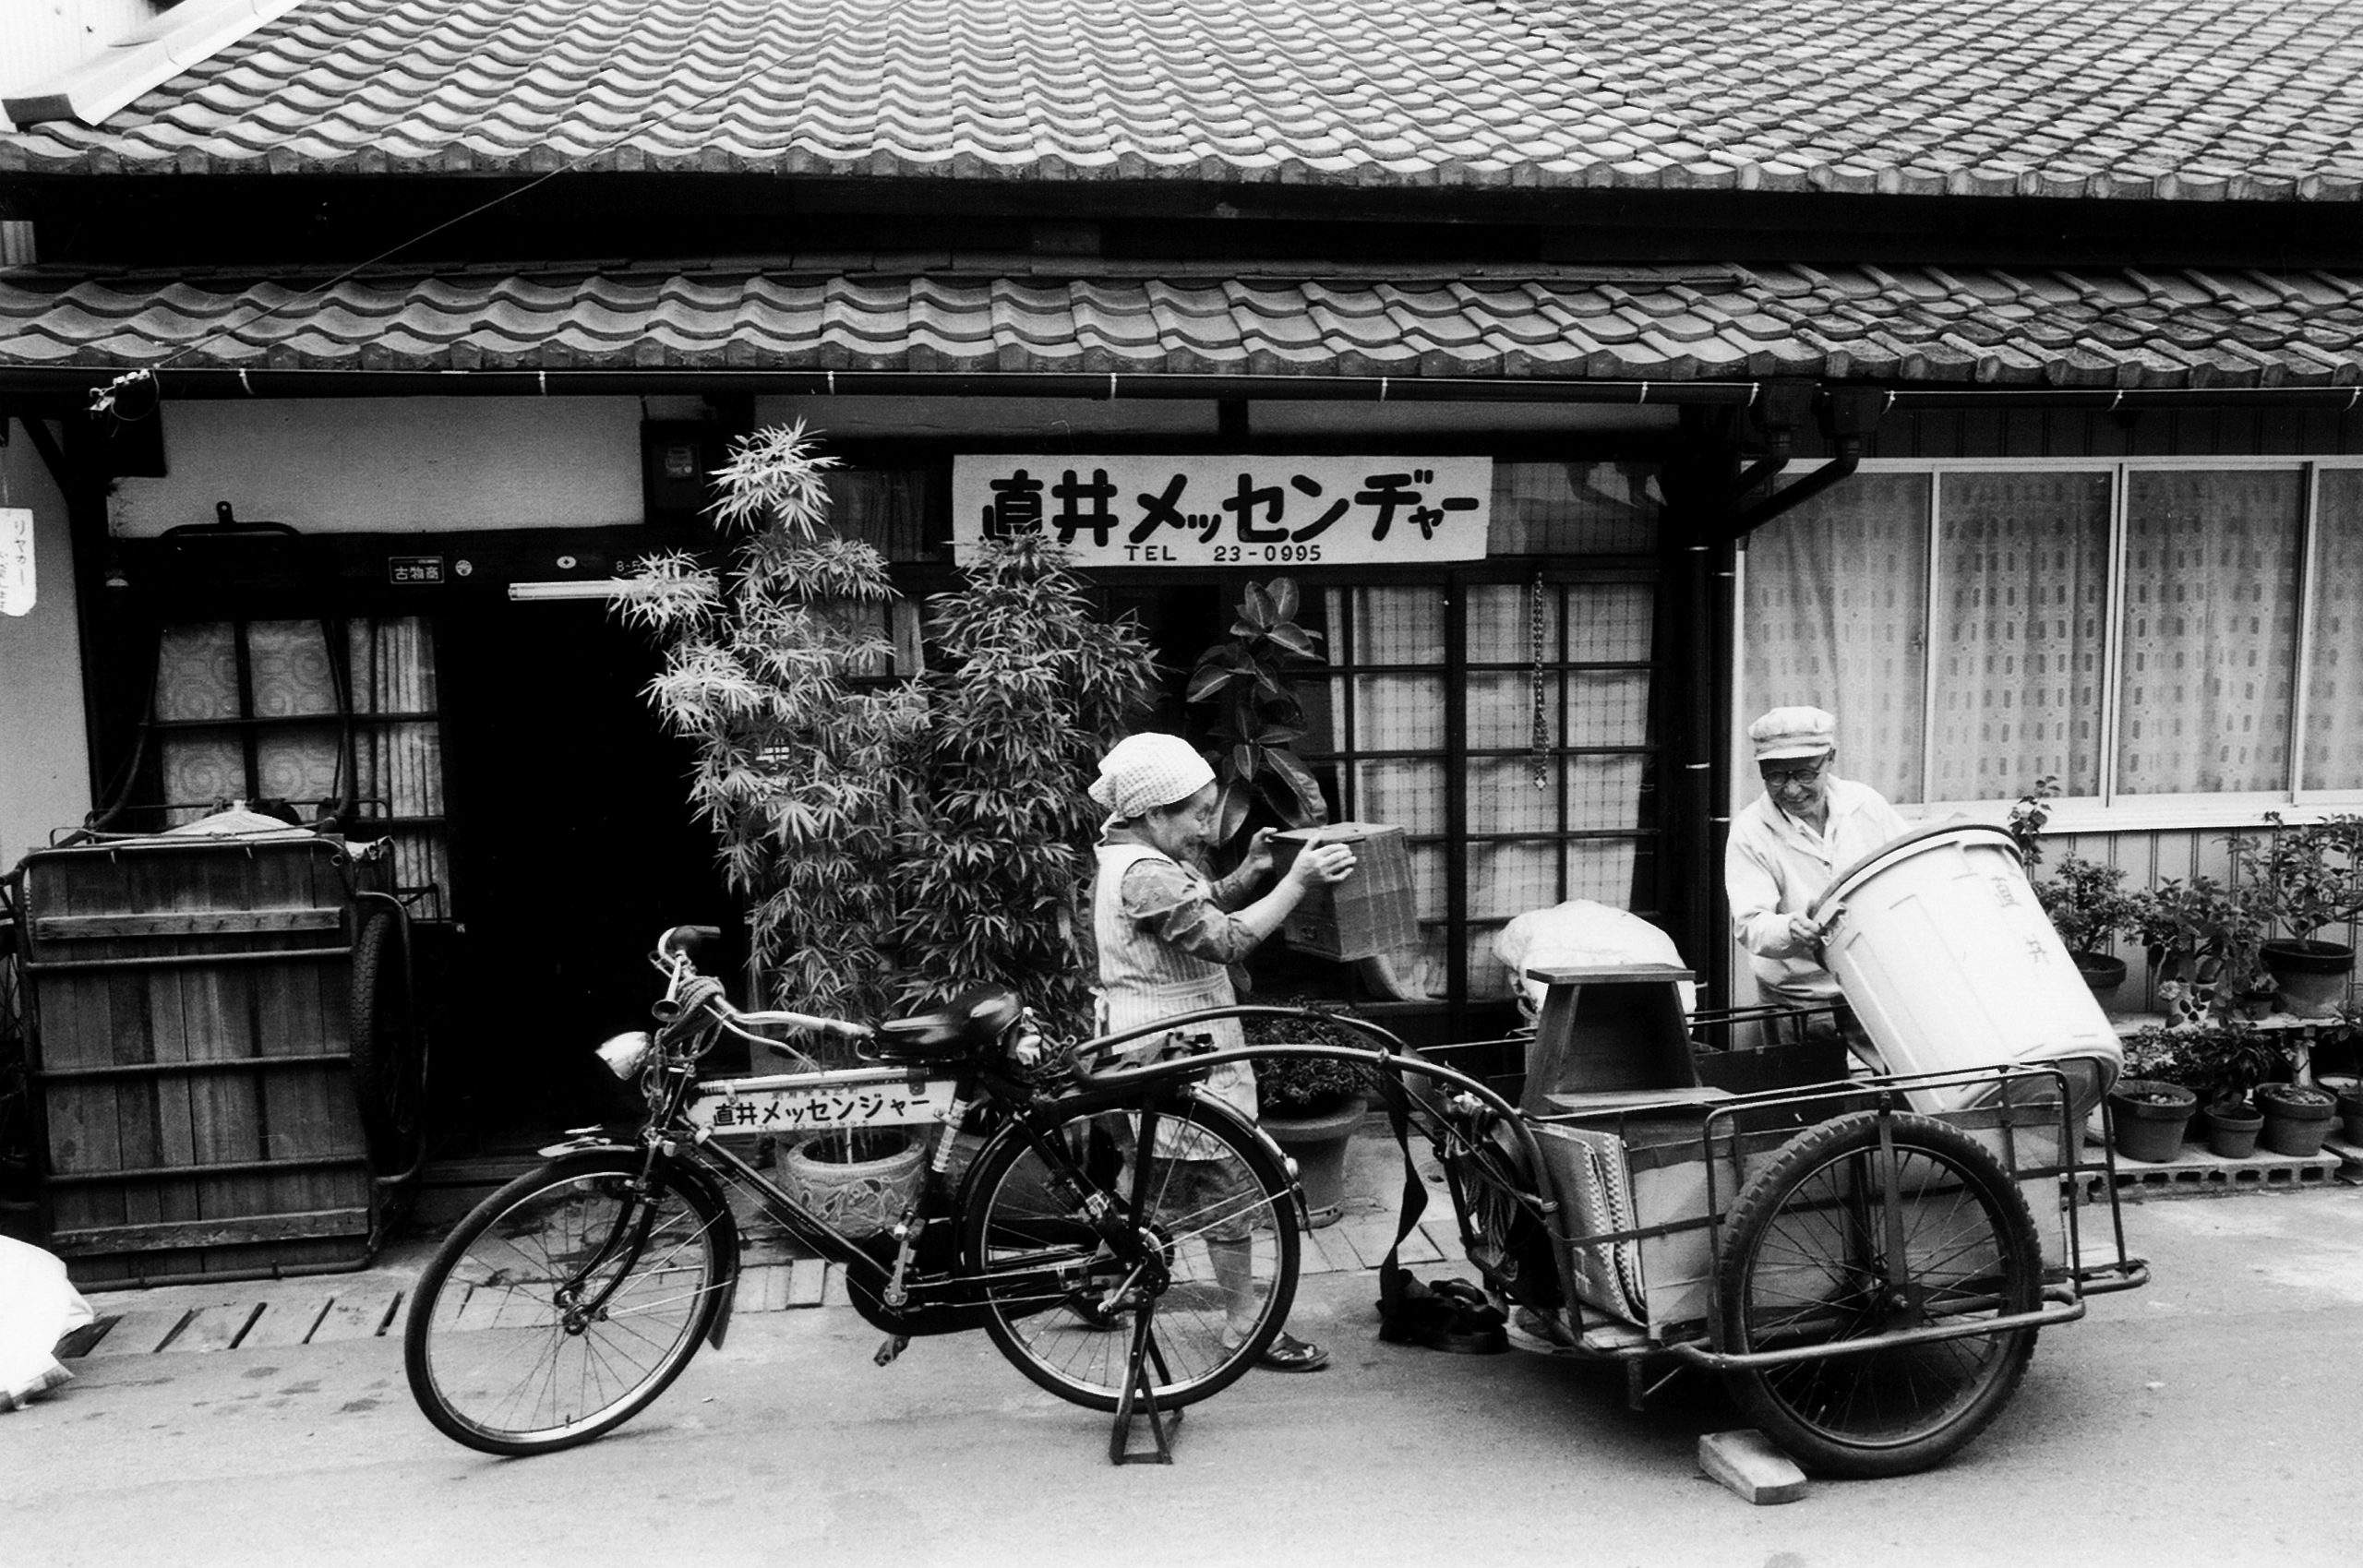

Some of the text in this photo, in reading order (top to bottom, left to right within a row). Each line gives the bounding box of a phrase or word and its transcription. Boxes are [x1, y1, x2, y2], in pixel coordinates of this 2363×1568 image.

[982, 469, 1480, 546] 直井メッセンヂャー
[1123, 545, 1322, 562] TEL 23-0995
[394, 565, 439, 581] 古物商
[712, 1093, 930, 1127] 直井メッセンジャー
